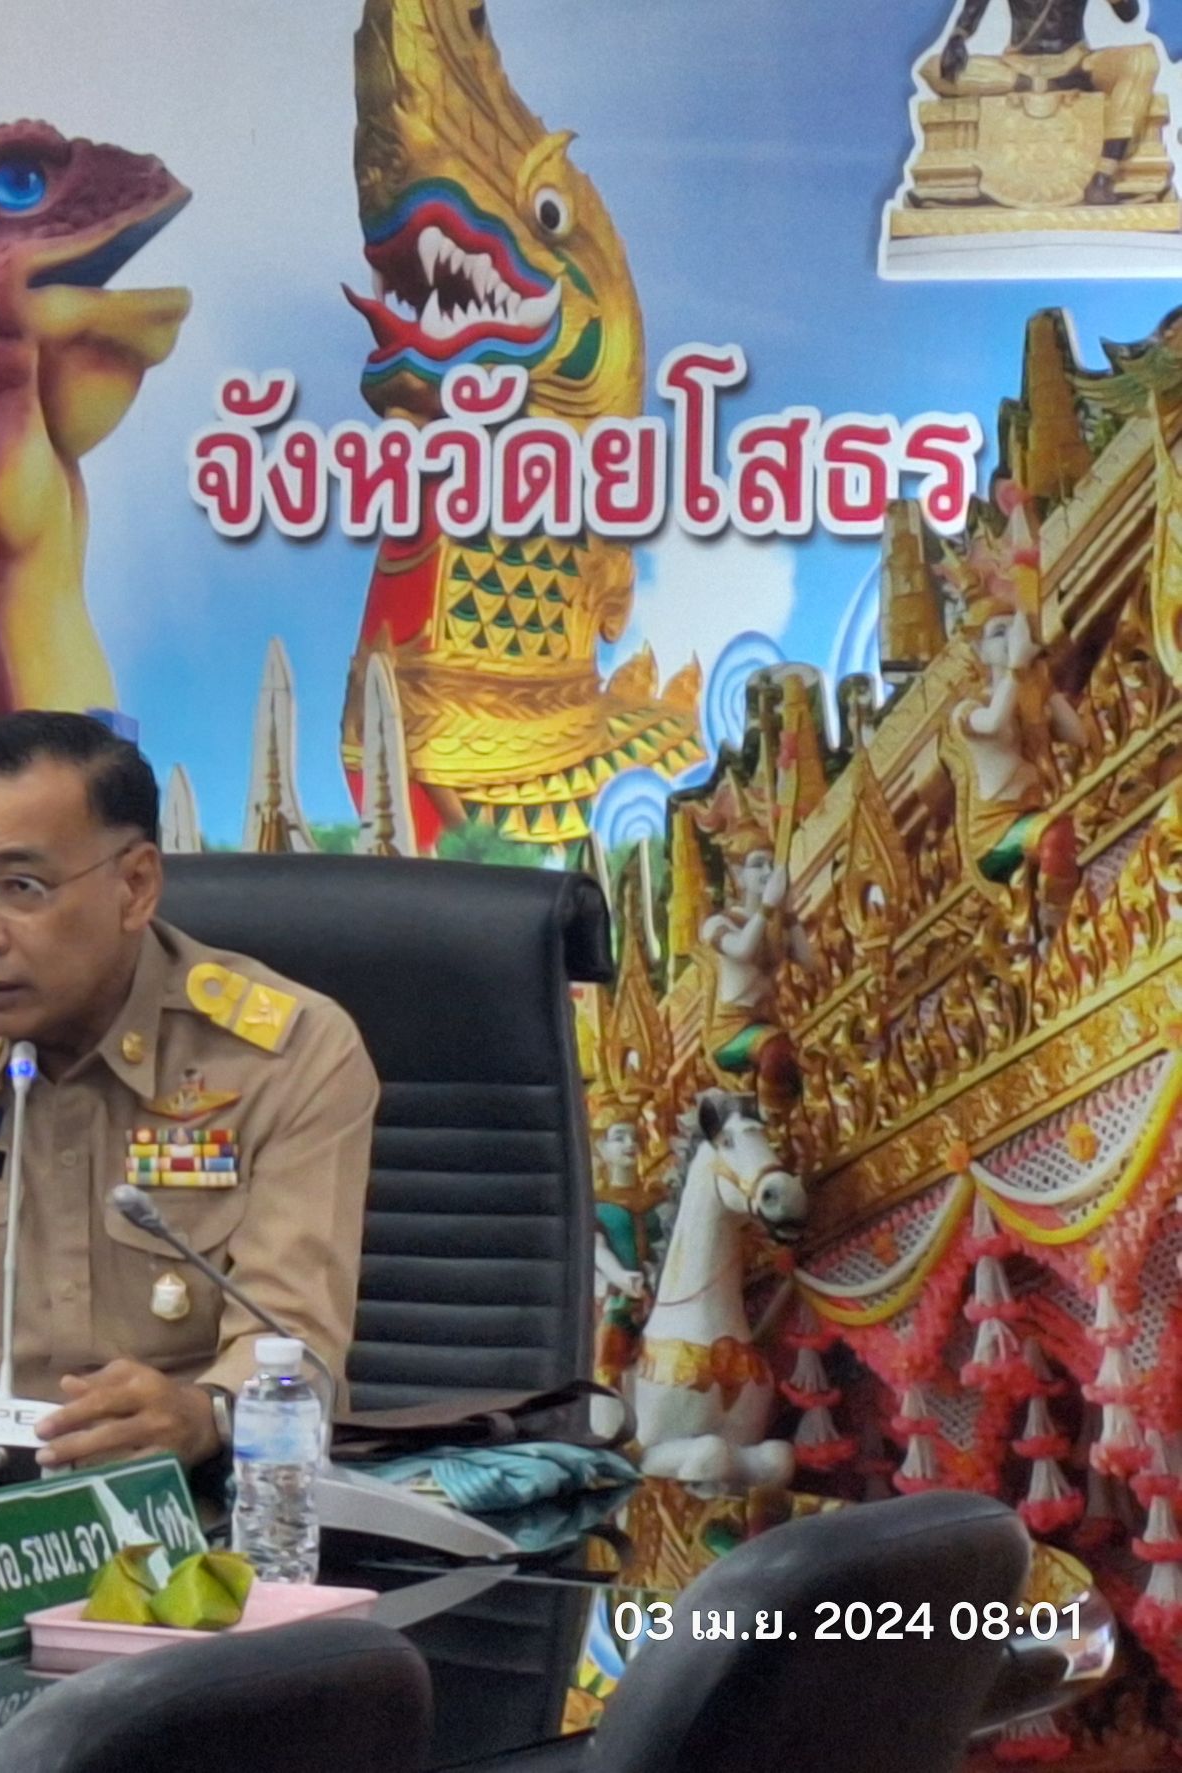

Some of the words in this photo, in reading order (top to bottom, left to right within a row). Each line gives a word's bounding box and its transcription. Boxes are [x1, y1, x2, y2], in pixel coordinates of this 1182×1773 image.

[191, 345, 979, 530] จังหวัดยโสธร
